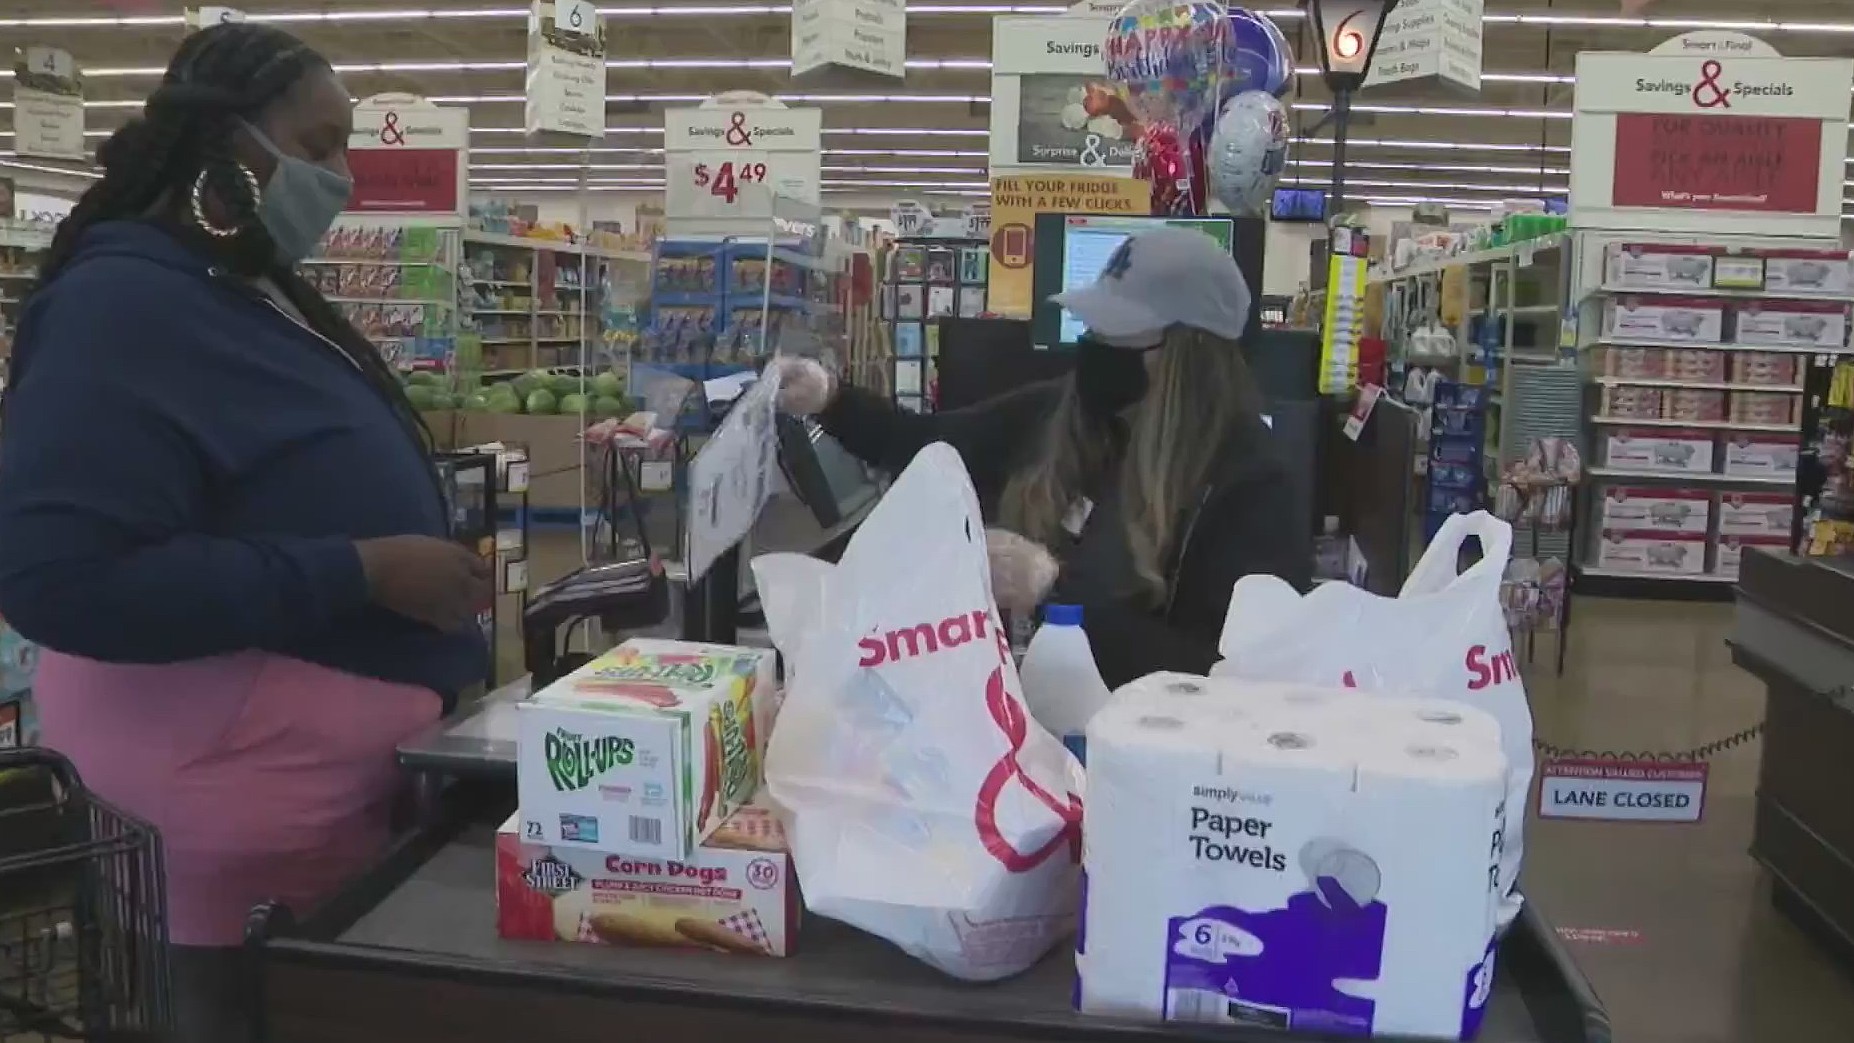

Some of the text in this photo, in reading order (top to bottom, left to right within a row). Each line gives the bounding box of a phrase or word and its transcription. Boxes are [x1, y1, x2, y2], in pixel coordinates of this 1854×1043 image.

[570, 4, 582, 27] 6
[1334, 9, 1365, 58] 6
[1047, 40, 1100, 58] Savings
[43, 54, 56, 72] 4
[1635, 60, 1794, 108] Savings & Specials
[726, 110, 752, 146] &
[1080, 134, 1107, 168] &
[995, 179, 1119, 194] FILL YOUR FRIDGE
[995, 194, 1032, 208] WITH
[1037, 196, 1047, 208] A
[1052, 196, 1081, 209] FEW
[1554, 789, 1691, 809] LANE CLOSED
[526, 819, 544, 836] 72
[1191, 806, 1273, 839] Paper
[1188, 834, 1287, 872] Towels
[605, 853, 728, 885] Corn Dogs
[1195, 924, 1212, 945] 6
